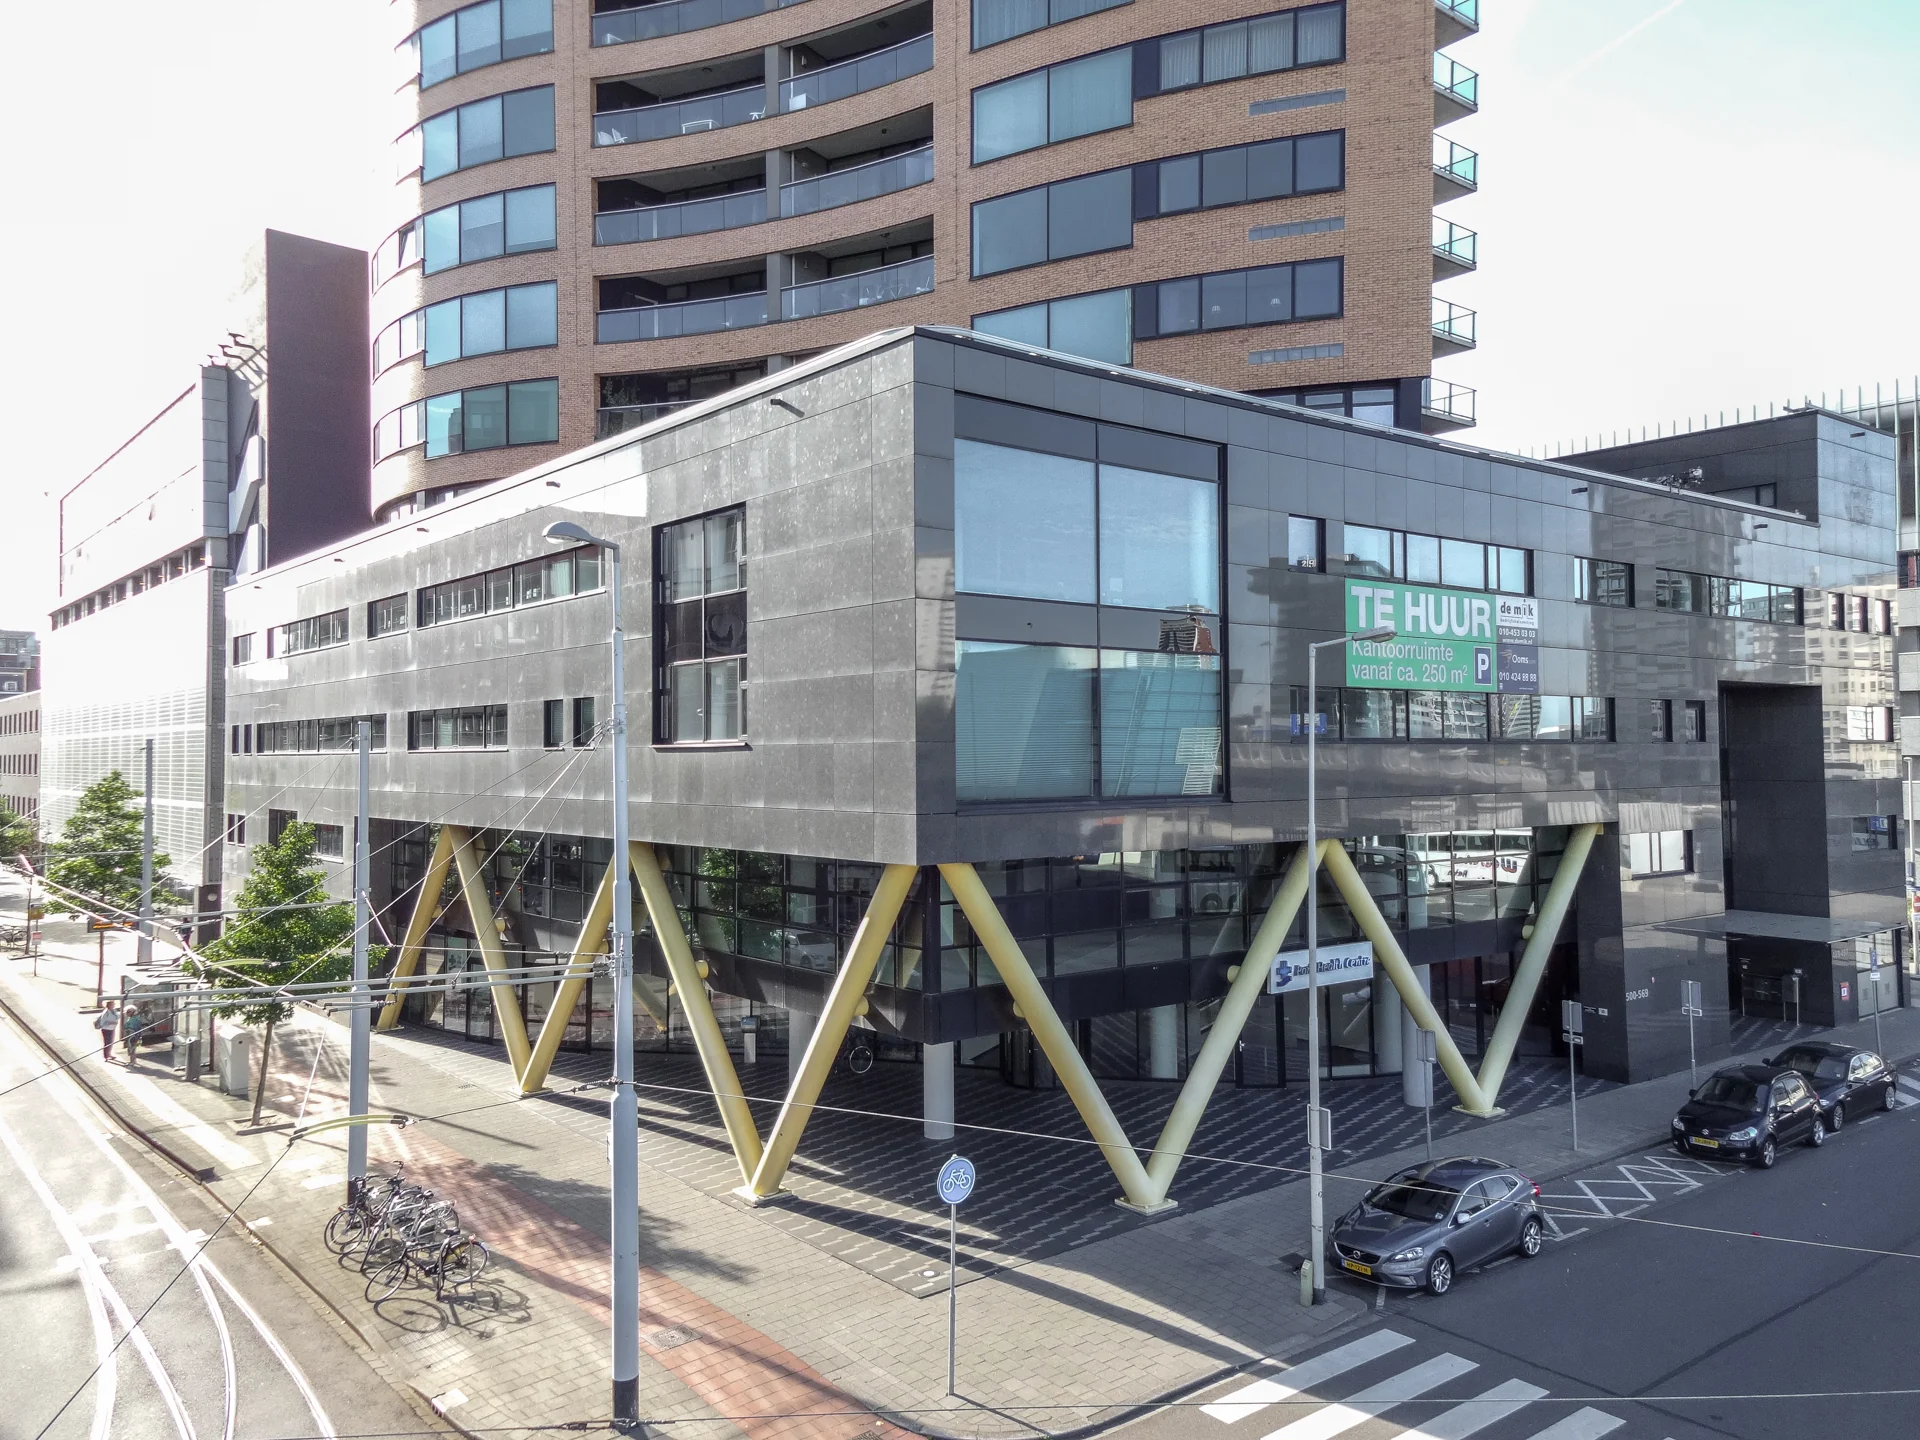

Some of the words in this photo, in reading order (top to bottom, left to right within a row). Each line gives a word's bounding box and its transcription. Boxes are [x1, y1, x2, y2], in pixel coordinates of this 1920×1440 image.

[1351, 586, 1395, 631] TE
[1404, 592, 1491, 638] HUUR
[1500, 602, 1511, 614] de
[1513, 599, 1534, 617] mik
[1499, 627, 1520, 637] 010-453
[1529, 630, 1535, 638] 03
[1353, 640, 1453, 661] Kantoorruimte
[1512, 654, 1529, 664] Ooms
[1352, 662, 1393, 681] vanaf
[1396, 666, 1418, 681] ca.
[1422, 663, 1447, 683] 250
[1477, 653, 1489, 679] P
[1499, 672, 1509, 681] 010
[1511, 672, 1521, 682] 424
[1316, 957, 1343, 973] Health
[1625, 988, 1649, 1002] 500-569
